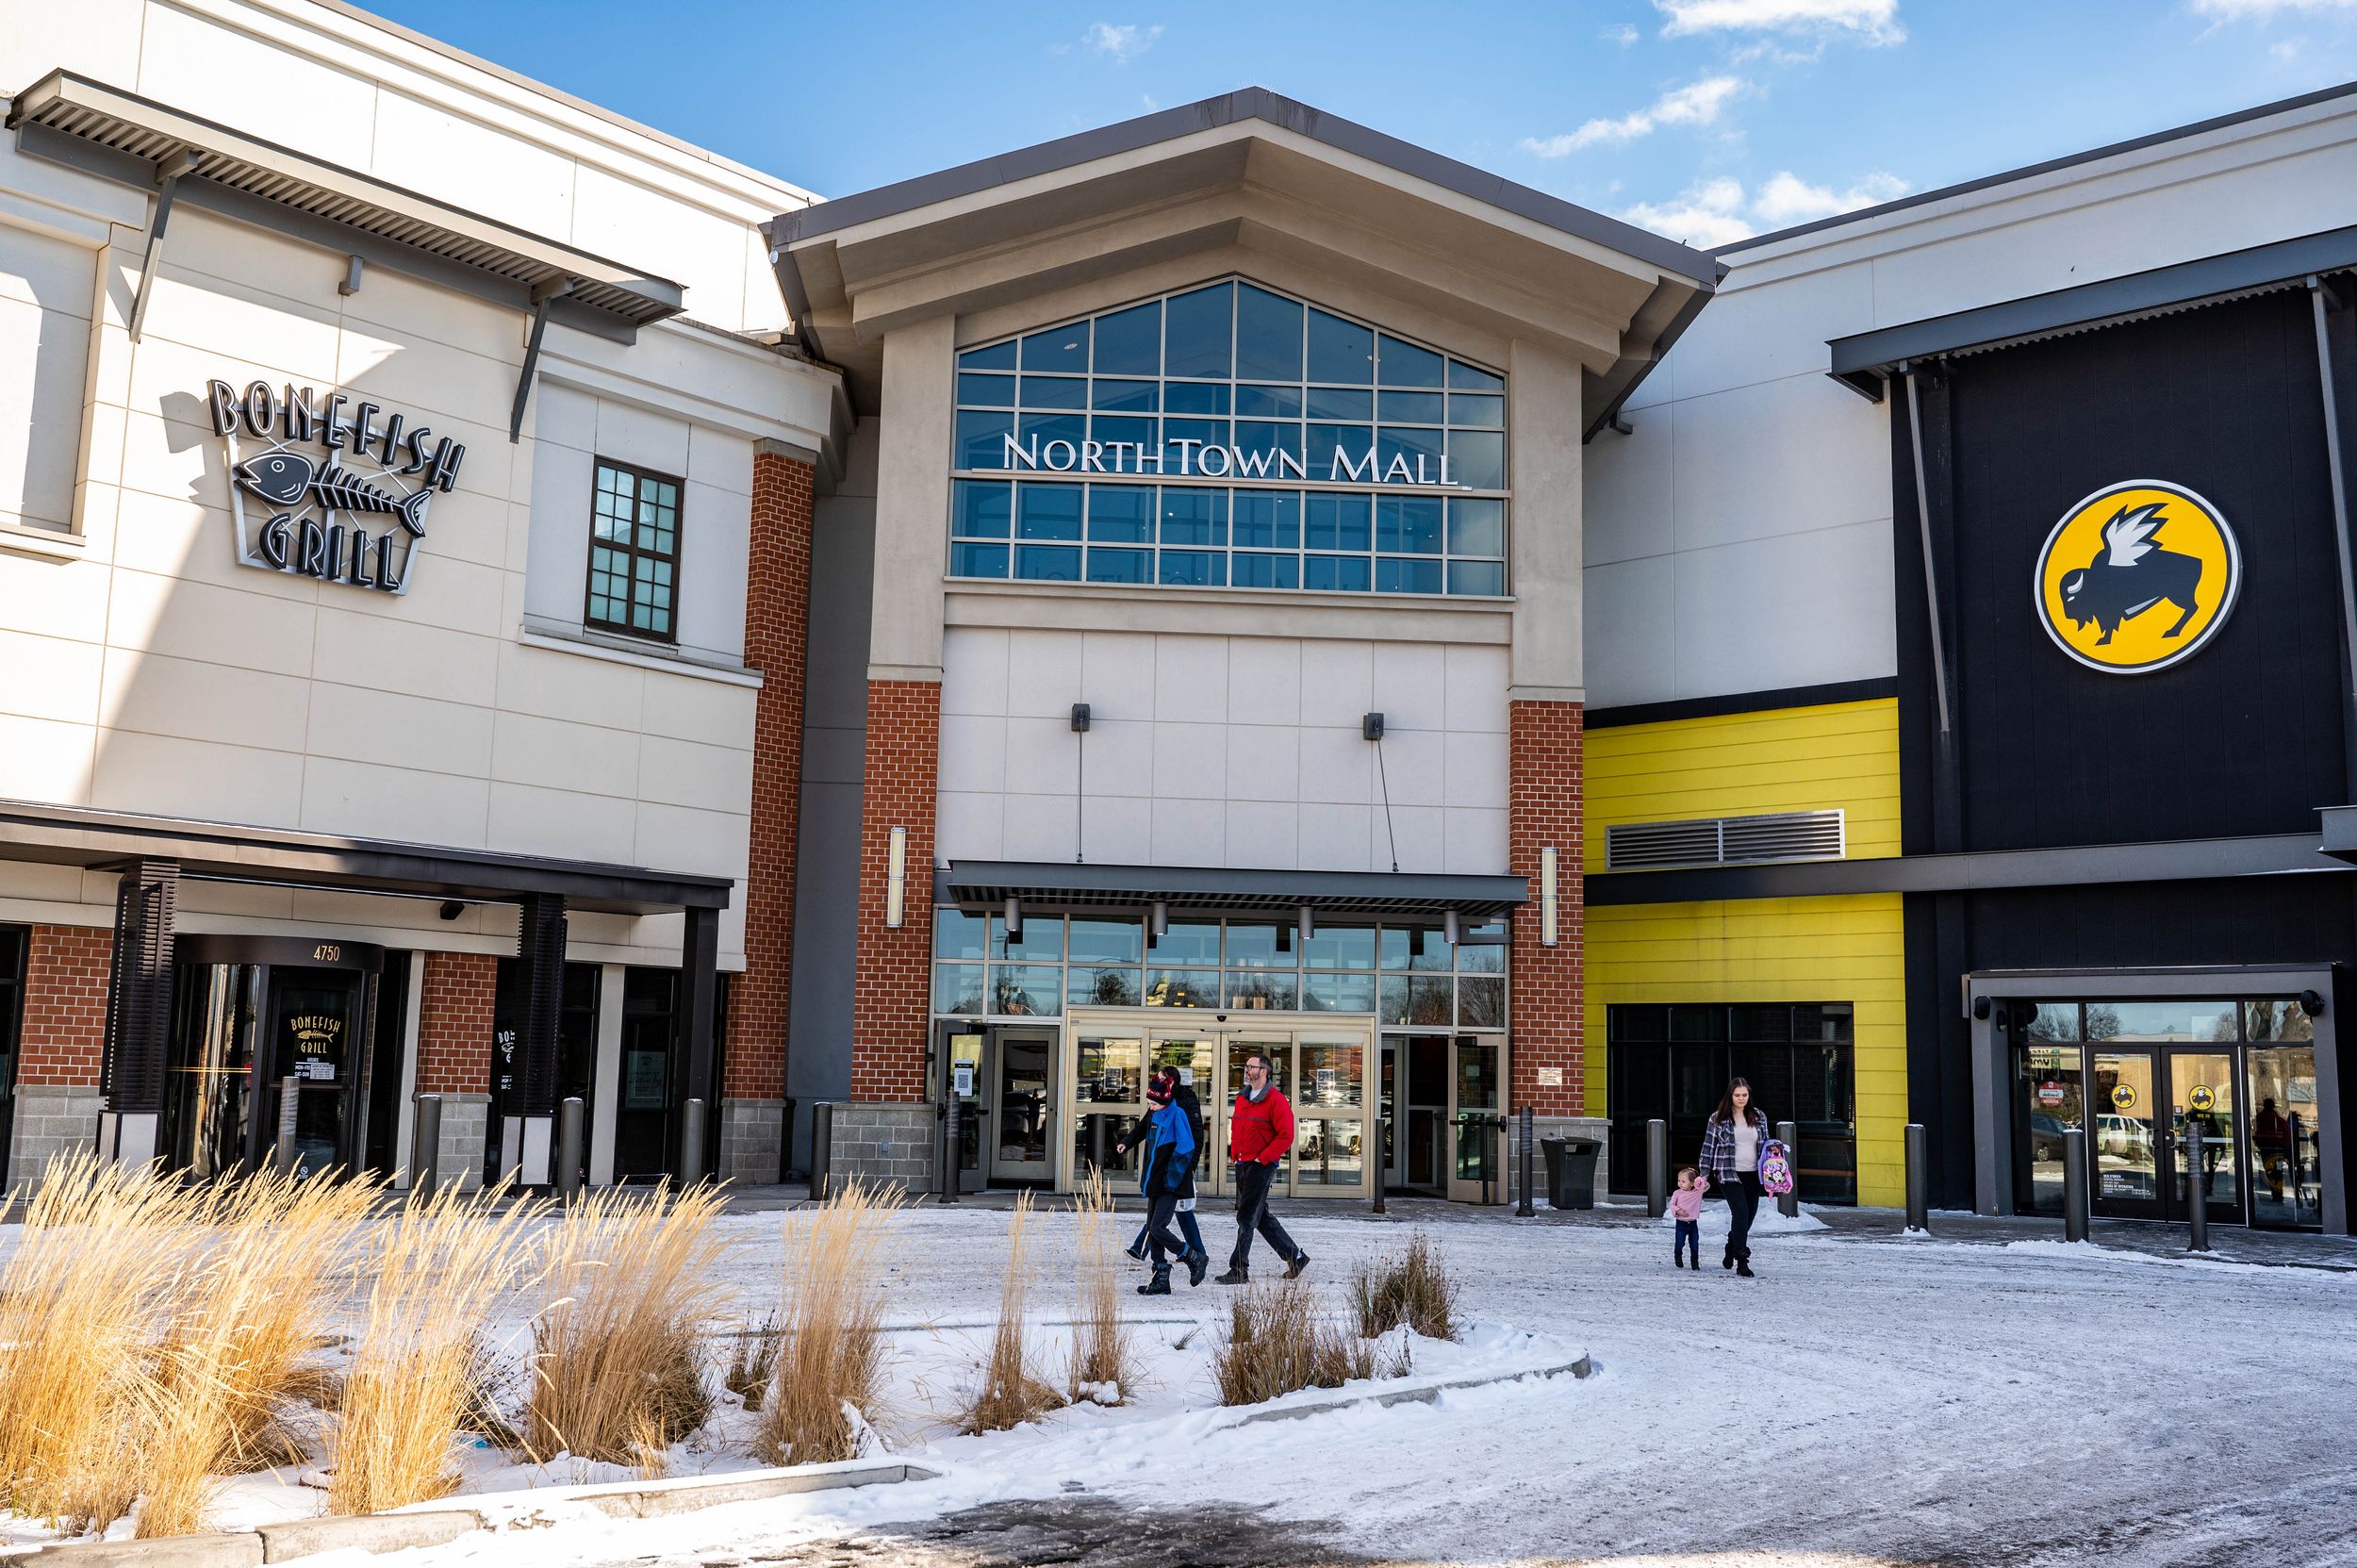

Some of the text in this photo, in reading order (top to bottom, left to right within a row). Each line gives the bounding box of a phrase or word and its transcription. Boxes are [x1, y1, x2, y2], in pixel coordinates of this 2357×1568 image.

[206, 379, 466, 492] BONEFISH
[1328, 443, 1459, 487] MALL
[259, 512, 402, 590] GRILL
[313, 945, 340, 962] 4750
[290, 1015, 341, 1033] BONEFISH
[301, 1042, 327, 1053] GRILL
